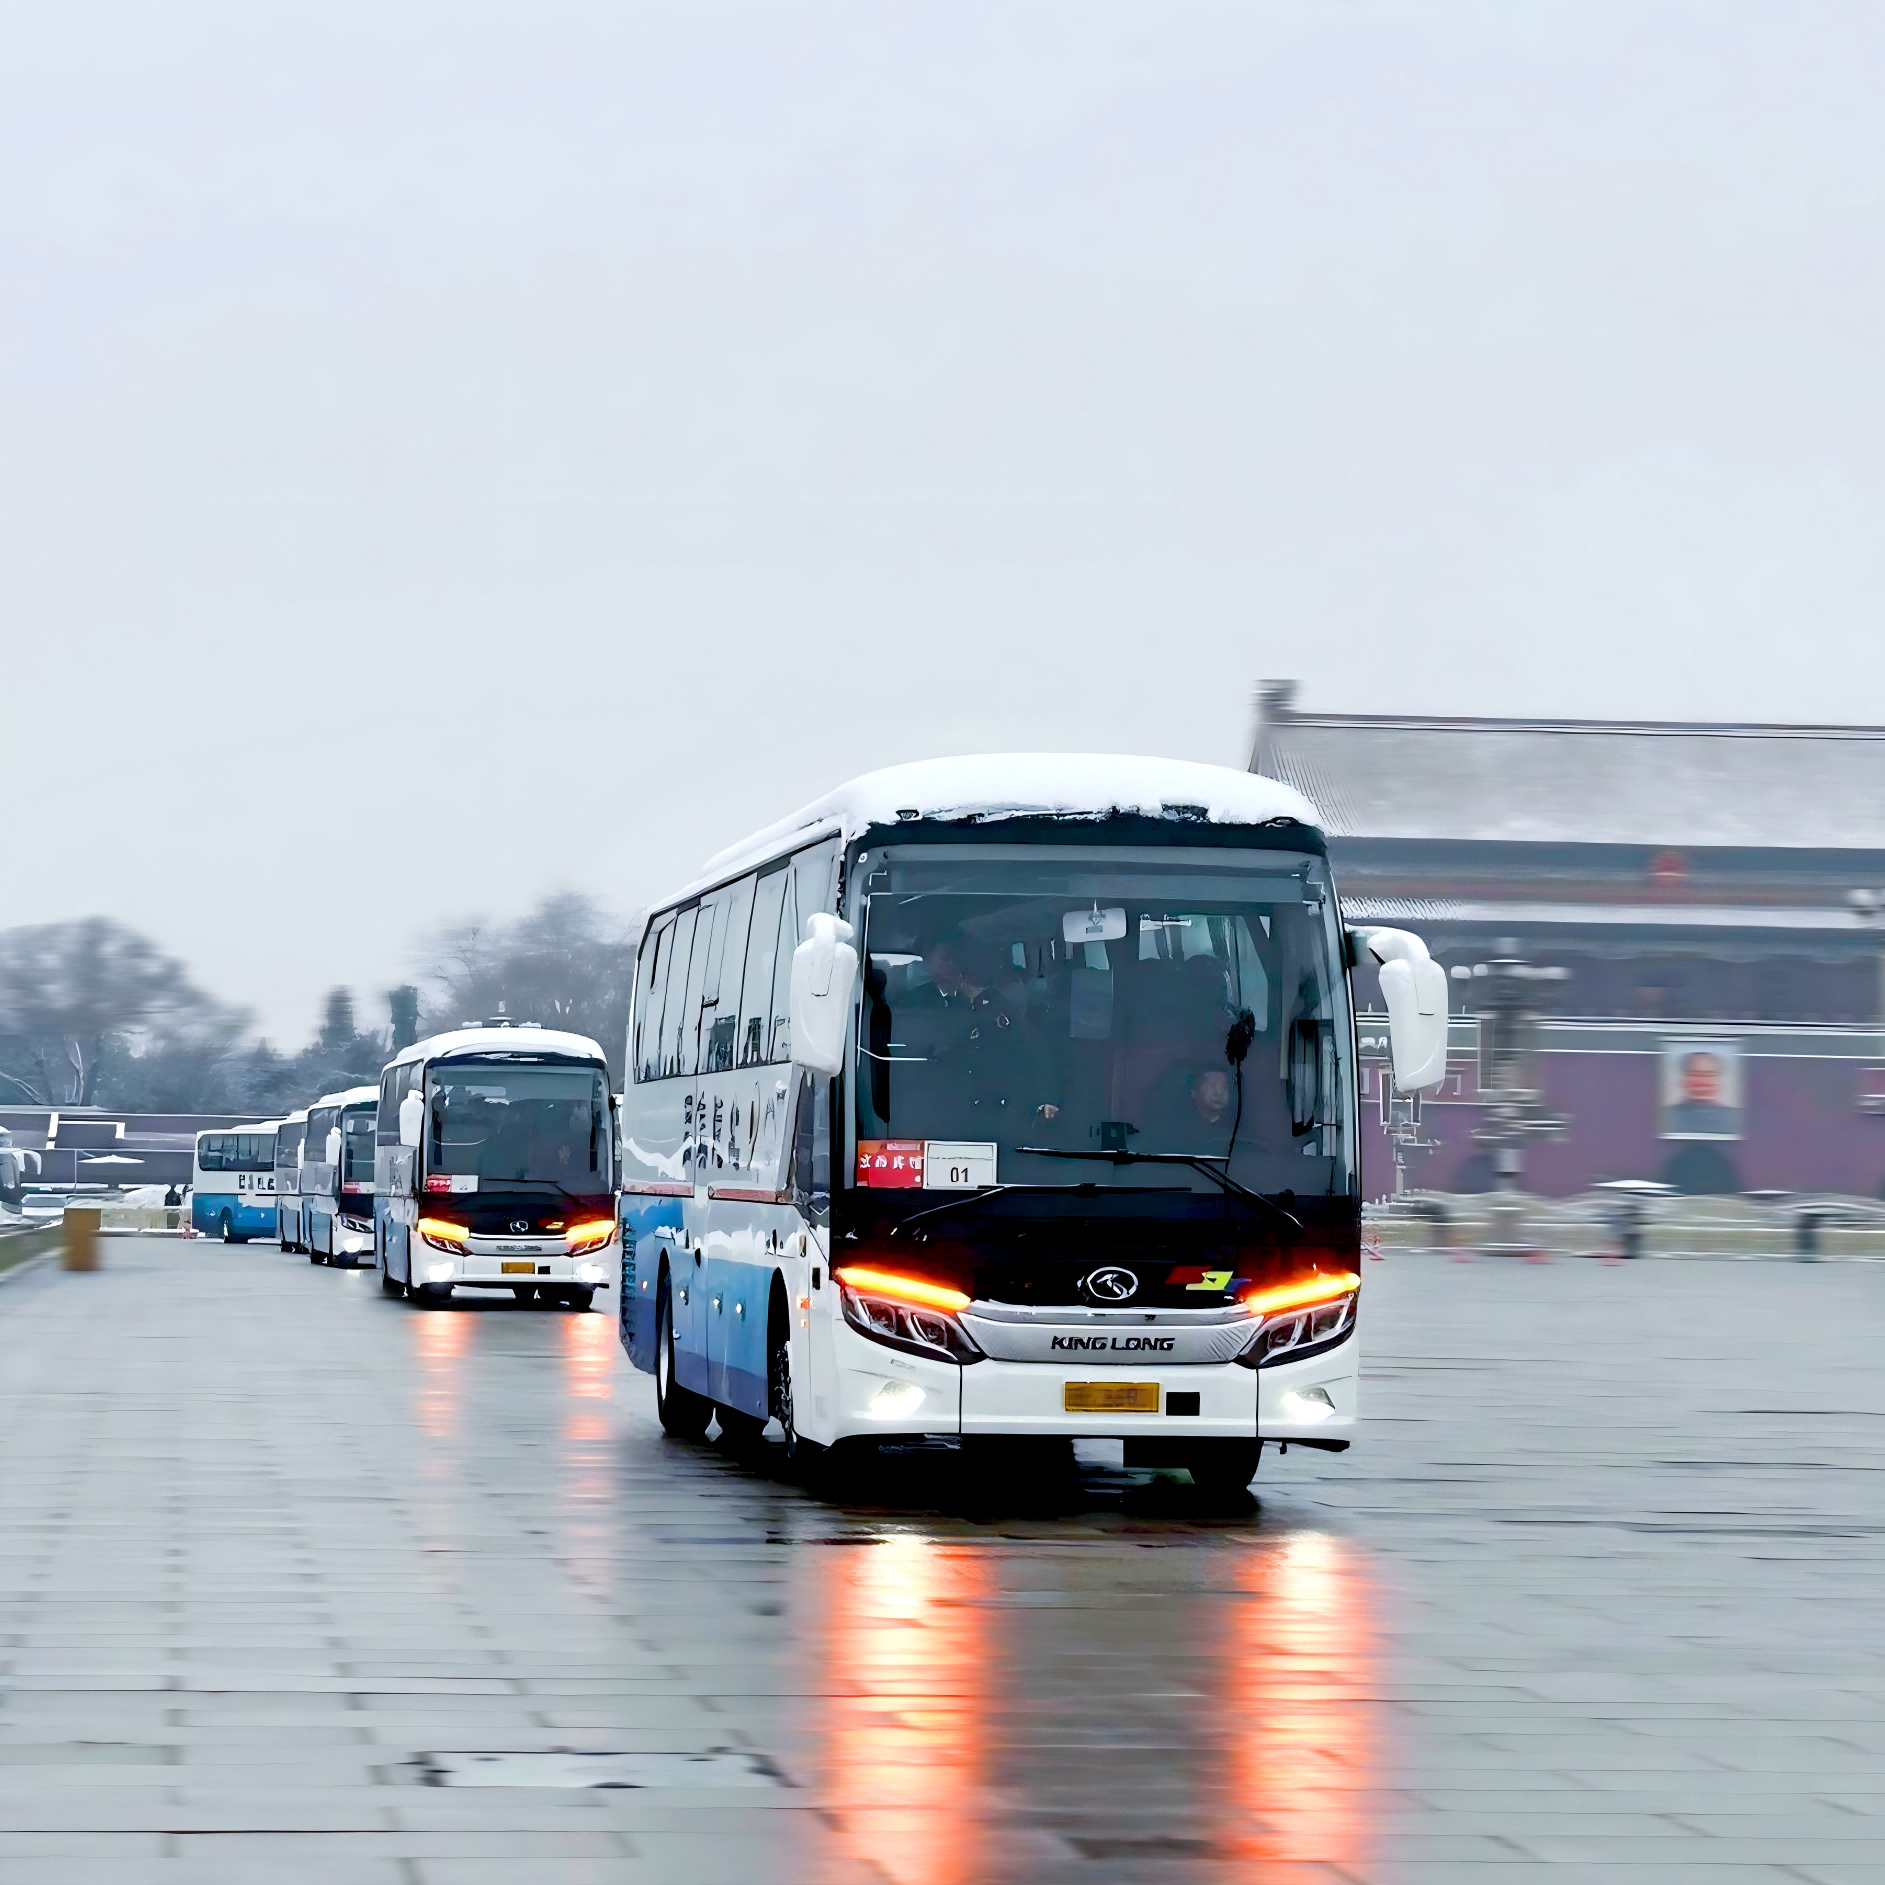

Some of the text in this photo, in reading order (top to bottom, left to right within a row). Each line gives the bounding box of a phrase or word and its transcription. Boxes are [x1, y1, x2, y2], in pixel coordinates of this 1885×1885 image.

[950, 1167, 969, 1183] 01
[1051, 1336, 1176, 1351] KING LONG
